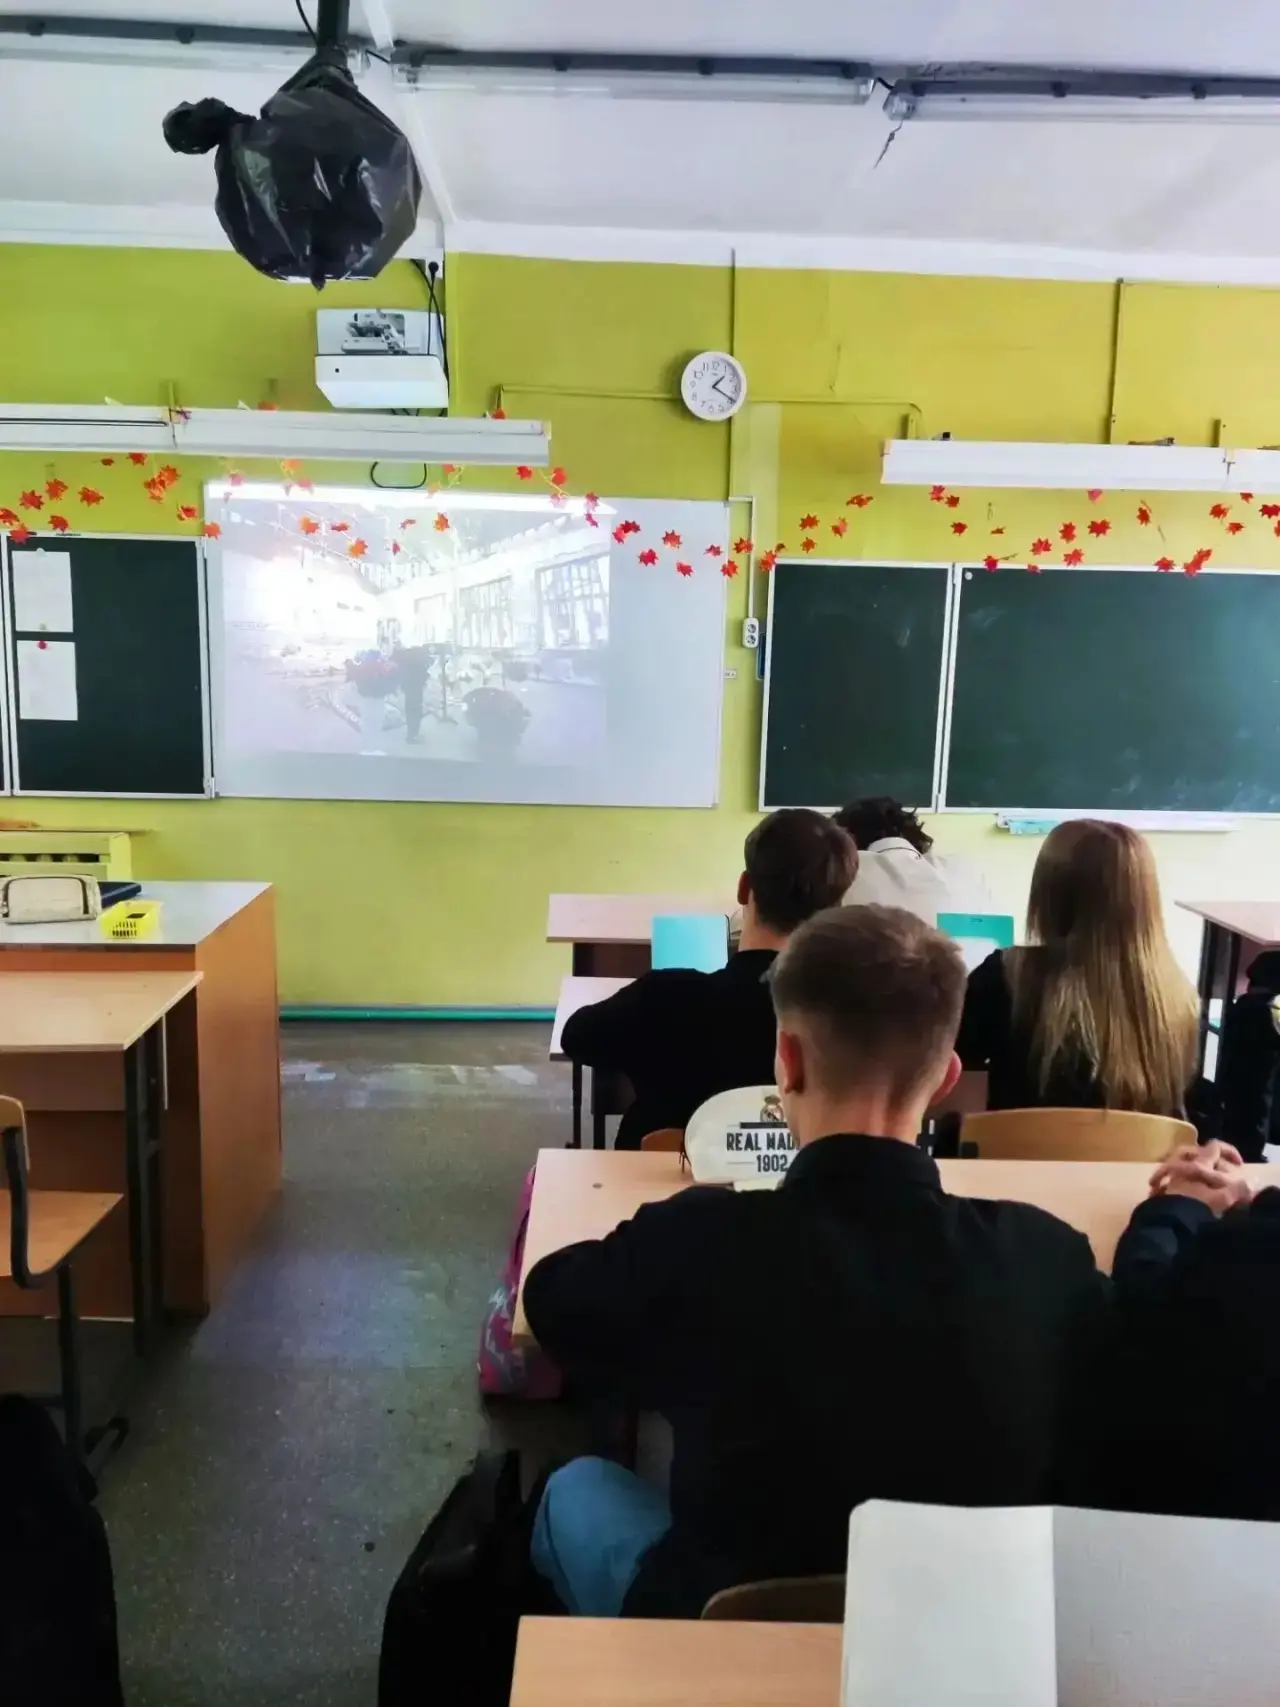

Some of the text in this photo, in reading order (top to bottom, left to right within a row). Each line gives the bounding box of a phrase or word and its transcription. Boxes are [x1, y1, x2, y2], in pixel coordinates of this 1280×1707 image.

[726, 1132, 795, 1151] REAL MAD
[756, 1154, 789, 1173] 1902
